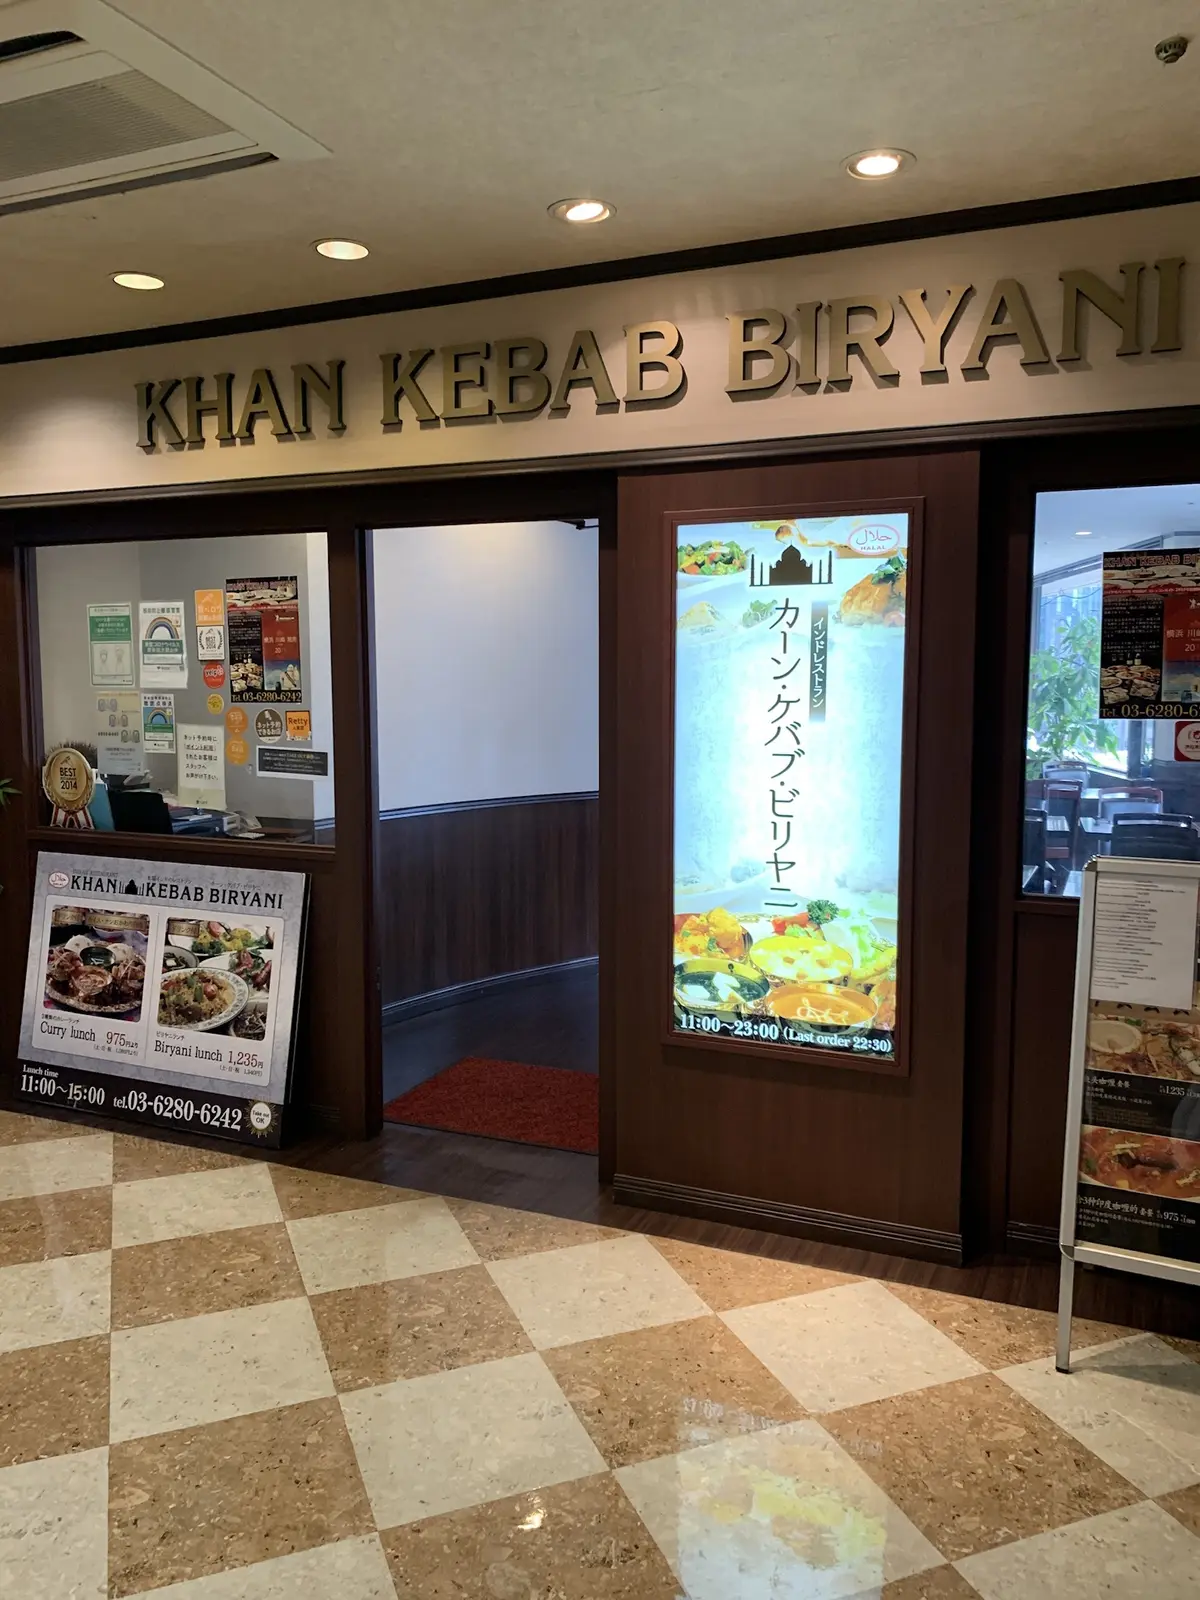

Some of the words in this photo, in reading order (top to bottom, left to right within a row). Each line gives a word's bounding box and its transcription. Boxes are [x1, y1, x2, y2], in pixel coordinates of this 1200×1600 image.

[136, 359, 346, 449] KHAN
[378, 320, 685, 430] KEBAB
[724, 256, 1186, 395] BIRYANI
[1139, 555, 1181, 566] KEBAB
[811, 617, 826, 709] インドレストラン
[243, 692, 302, 703] 03-6280-6242
[288, 717, 308, 726] Retty
[763, 597, 806, 908] カーン・ケバブ・ビリヤニ
[59, 767, 77, 777] BEST
[60, 781, 78, 790] 2014
[71, 875, 118, 894] KHAN
[146, 881, 204, 902] KEBAB
[209, 887, 284, 910] BIRYANI
[40, 1021, 67, 1040] Curry
[70, 1025, 96, 1042] lunch
[783, 1026, 815, 1044] (Last
[816, 1034, 850, 1048] order
[852, 1037, 893, 1053] 22:30)
[154, 1040, 192, 1057] Biryani
[195, 1046, 223, 1062] lunch
[23, 1065, 41, 1076] Lunch
[42, 1068, 59, 1079] time
[255, 1117, 265, 1125] OK
